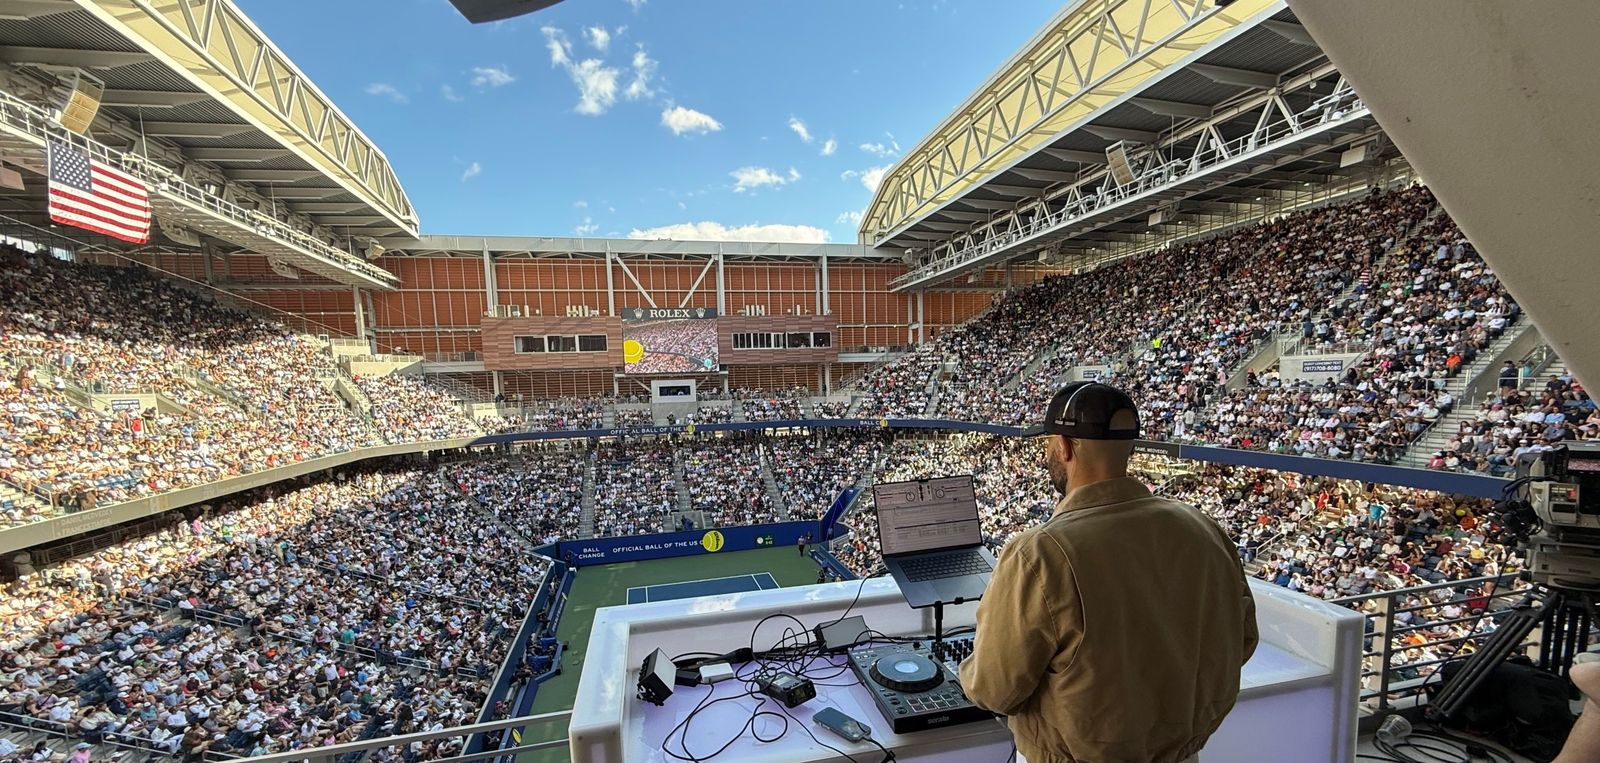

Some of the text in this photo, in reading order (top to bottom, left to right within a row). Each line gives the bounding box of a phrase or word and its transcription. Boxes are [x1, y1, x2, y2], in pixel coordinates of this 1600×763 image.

[649, 309, 691, 318] ROLEX
[612, 545, 643, 553] OFFICIAL
[578, 552, 605, 560] CHANGE
